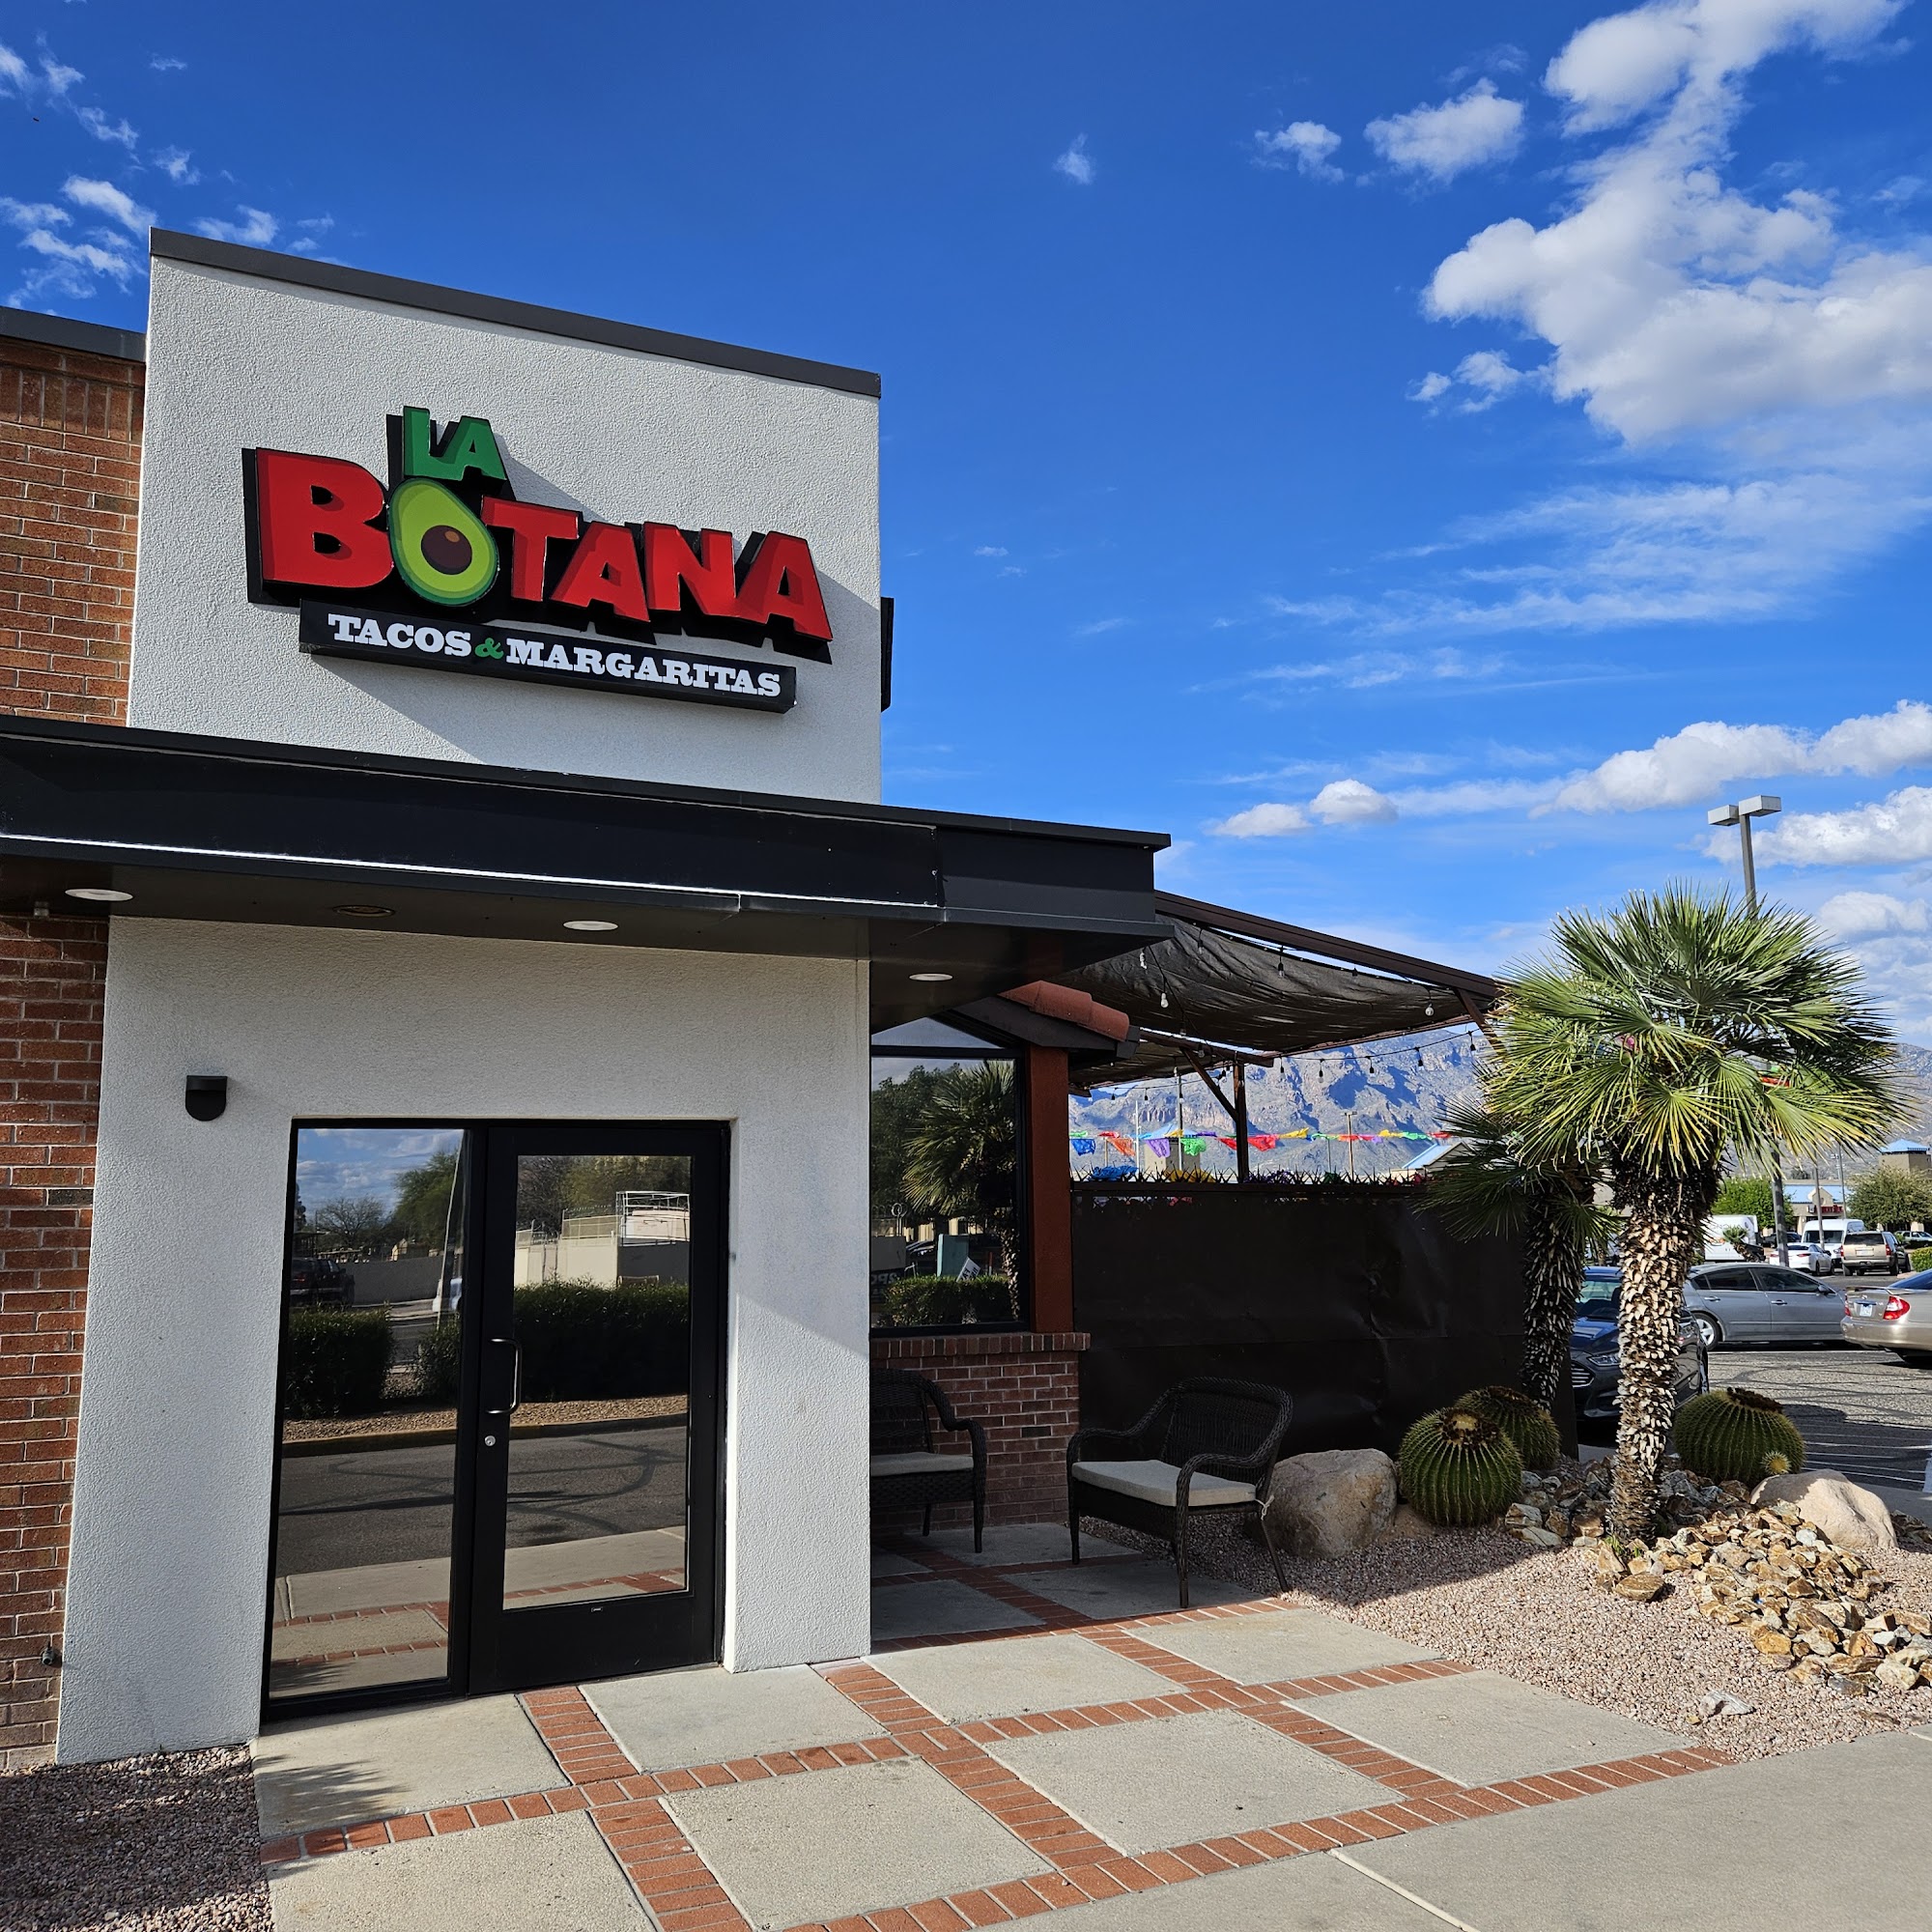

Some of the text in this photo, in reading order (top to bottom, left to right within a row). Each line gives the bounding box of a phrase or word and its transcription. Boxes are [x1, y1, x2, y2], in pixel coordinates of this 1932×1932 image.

[402, 406, 507, 481] LA
[256, 447, 833, 641] BOTANA
[327, 612, 781, 697] TACOS & MARGARITAS
